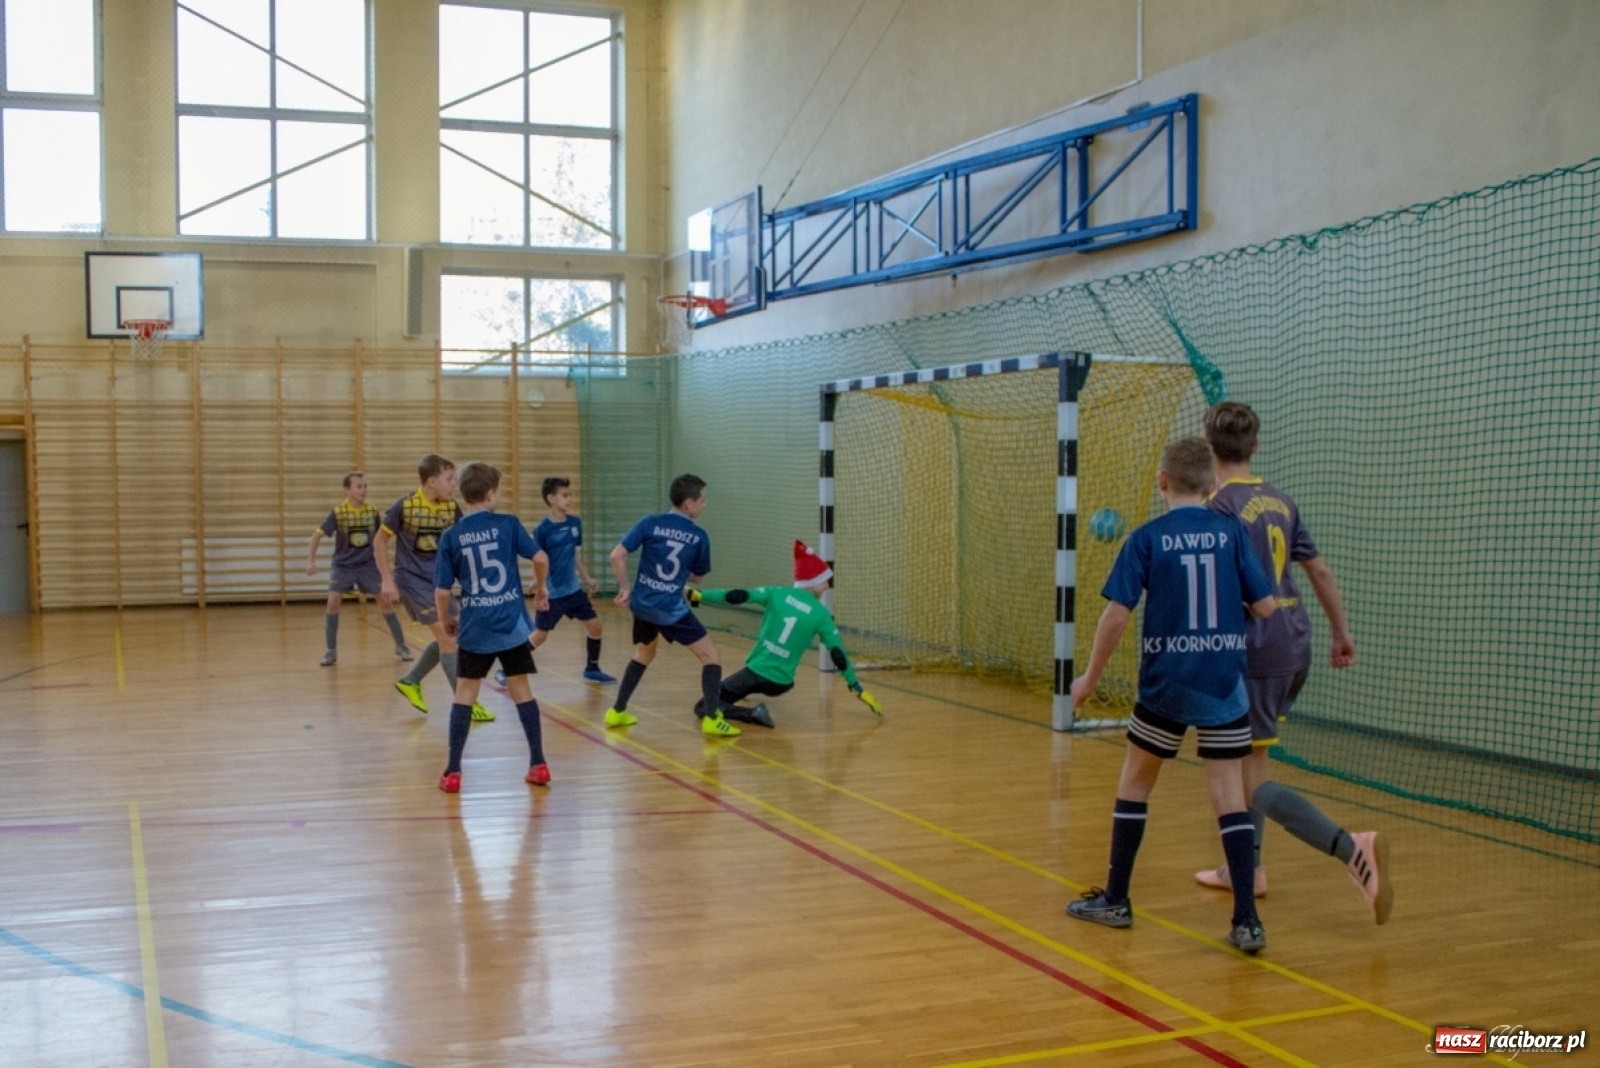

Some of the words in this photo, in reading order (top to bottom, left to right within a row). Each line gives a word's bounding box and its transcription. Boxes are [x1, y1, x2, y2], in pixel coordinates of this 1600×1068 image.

[459, 530, 490, 546] BRIAN
[492, 528, 499, 539] P
[653, 526, 693, 543] BARTOSZ
[693, 536, 700, 545] P
[1162, 533, 1215, 551] DAWID
[1219, 533, 1229, 549] P
[462, 542, 507, 595] 15
[656, 540, 685, 581] 3
[1180, 553, 1218, 630] 11
[777, 616, 798, 646] 1
[1144, 637, 1162, 653] KS
